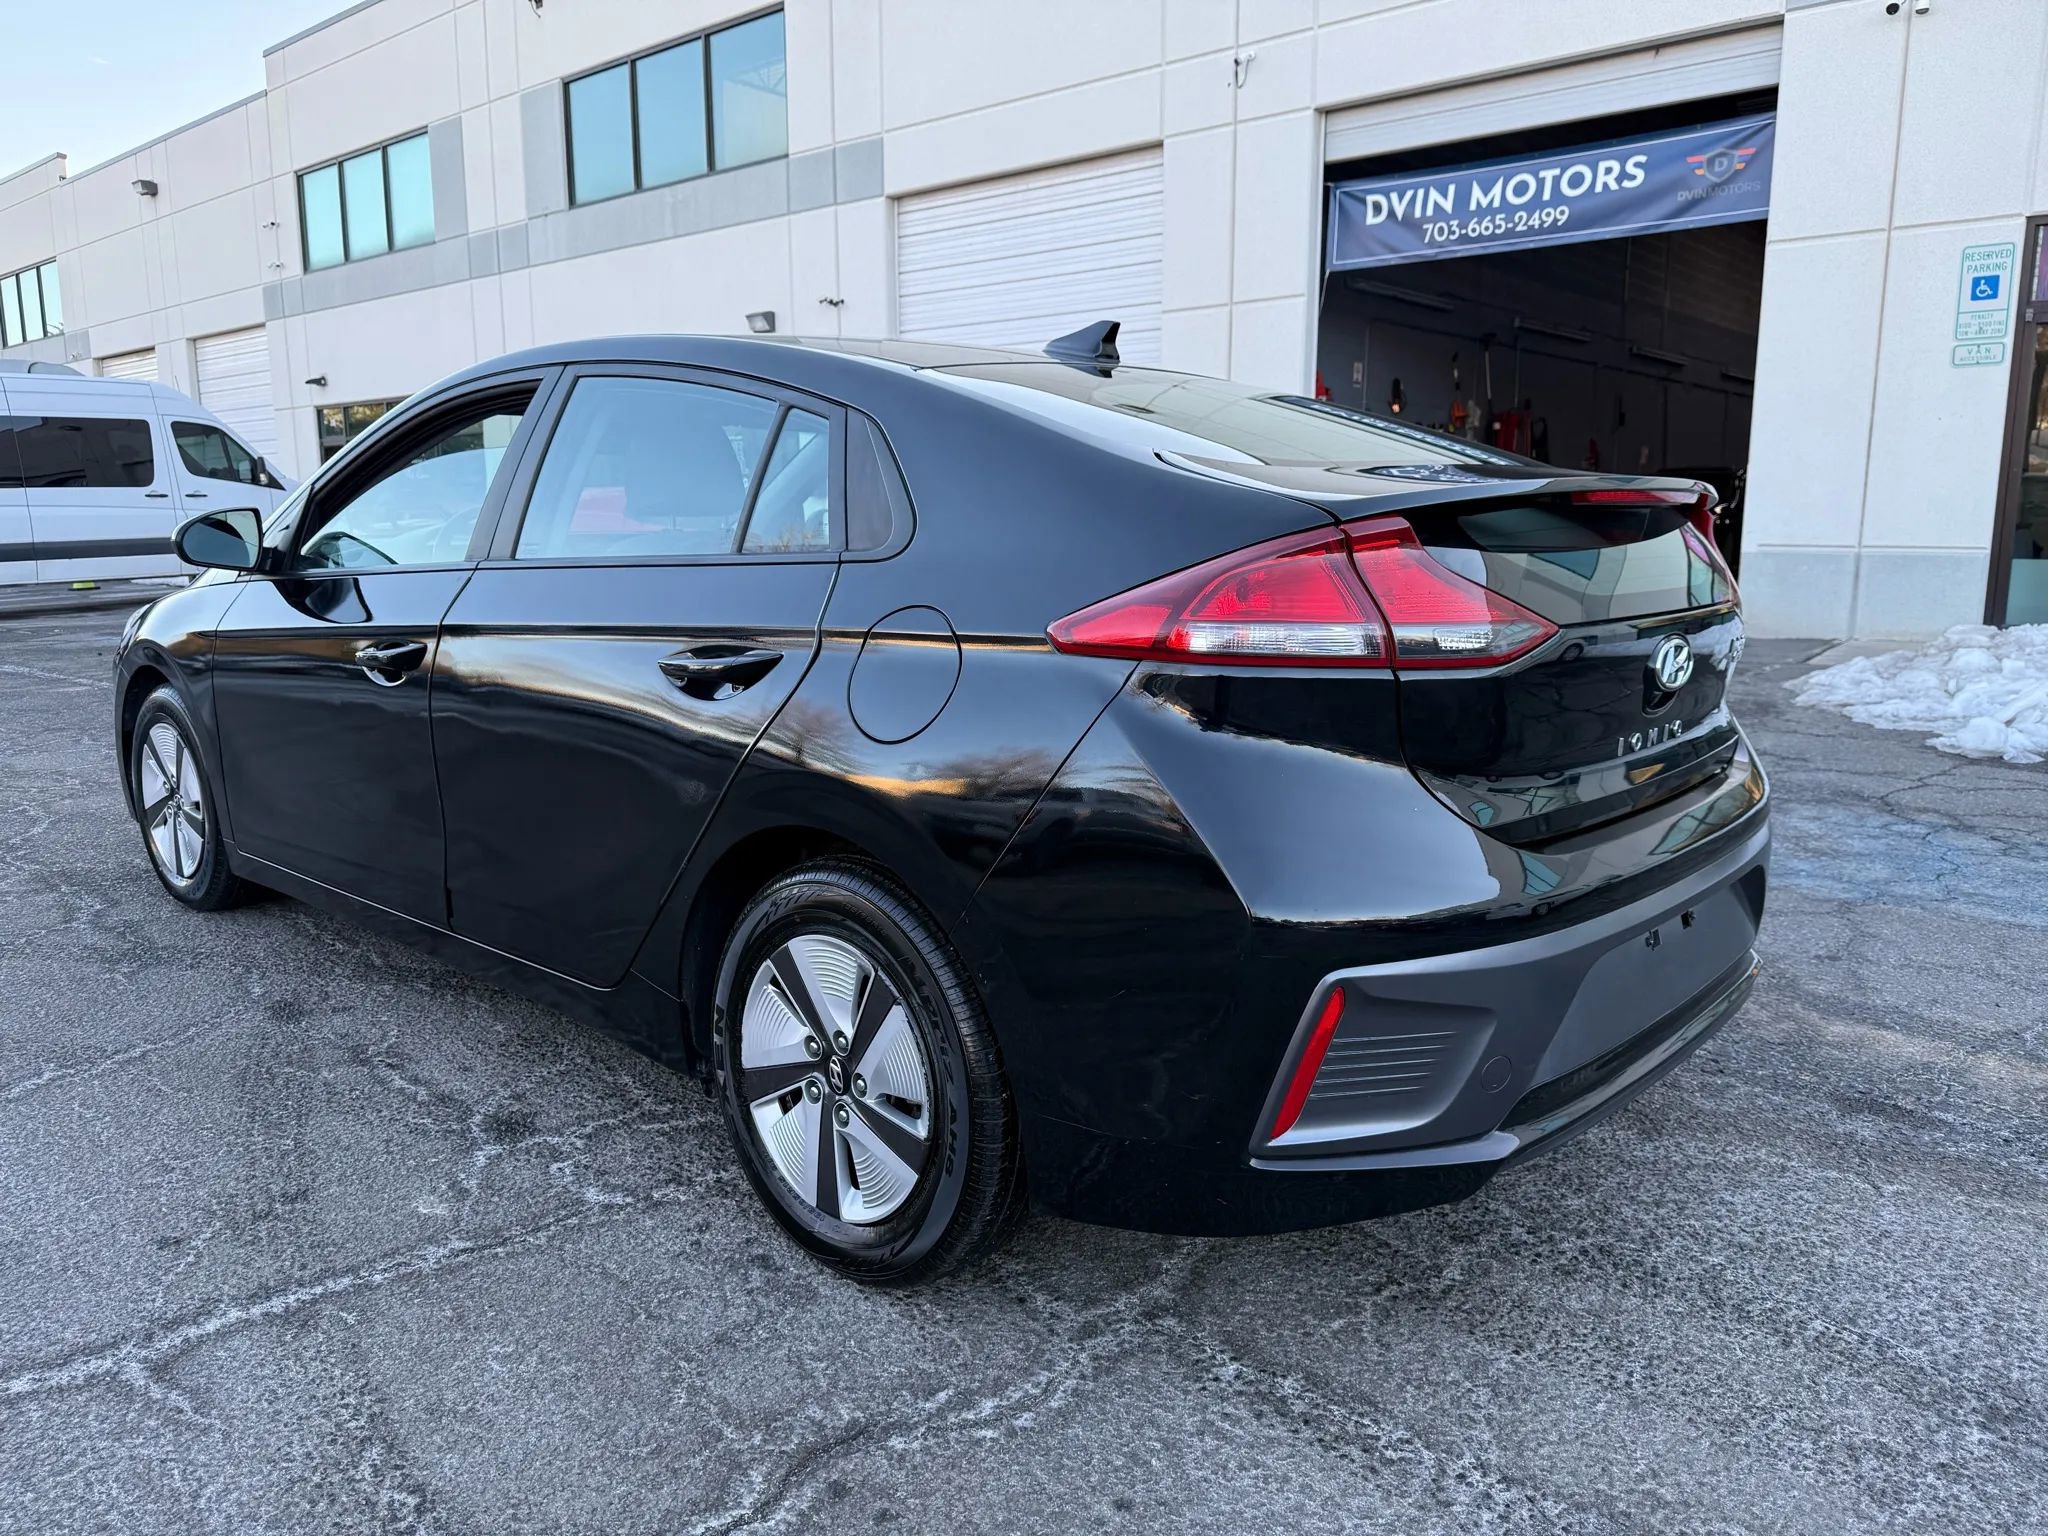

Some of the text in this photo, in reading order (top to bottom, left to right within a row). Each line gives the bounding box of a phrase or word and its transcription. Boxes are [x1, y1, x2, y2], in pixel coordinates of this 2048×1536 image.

[1714, 157, 1728, 172] D
[1365, 154, 1648, 225] DVIN MOTORS
[1422, 205, 1570, 244] 703-665-2499
[1965, 249, 2012, 263] RESERVED
[1967, 261, 2008, 274] PARKING
[1967, 346, 1992, 355] VAN
[1617, 719, 1682, 757] IONIQ
